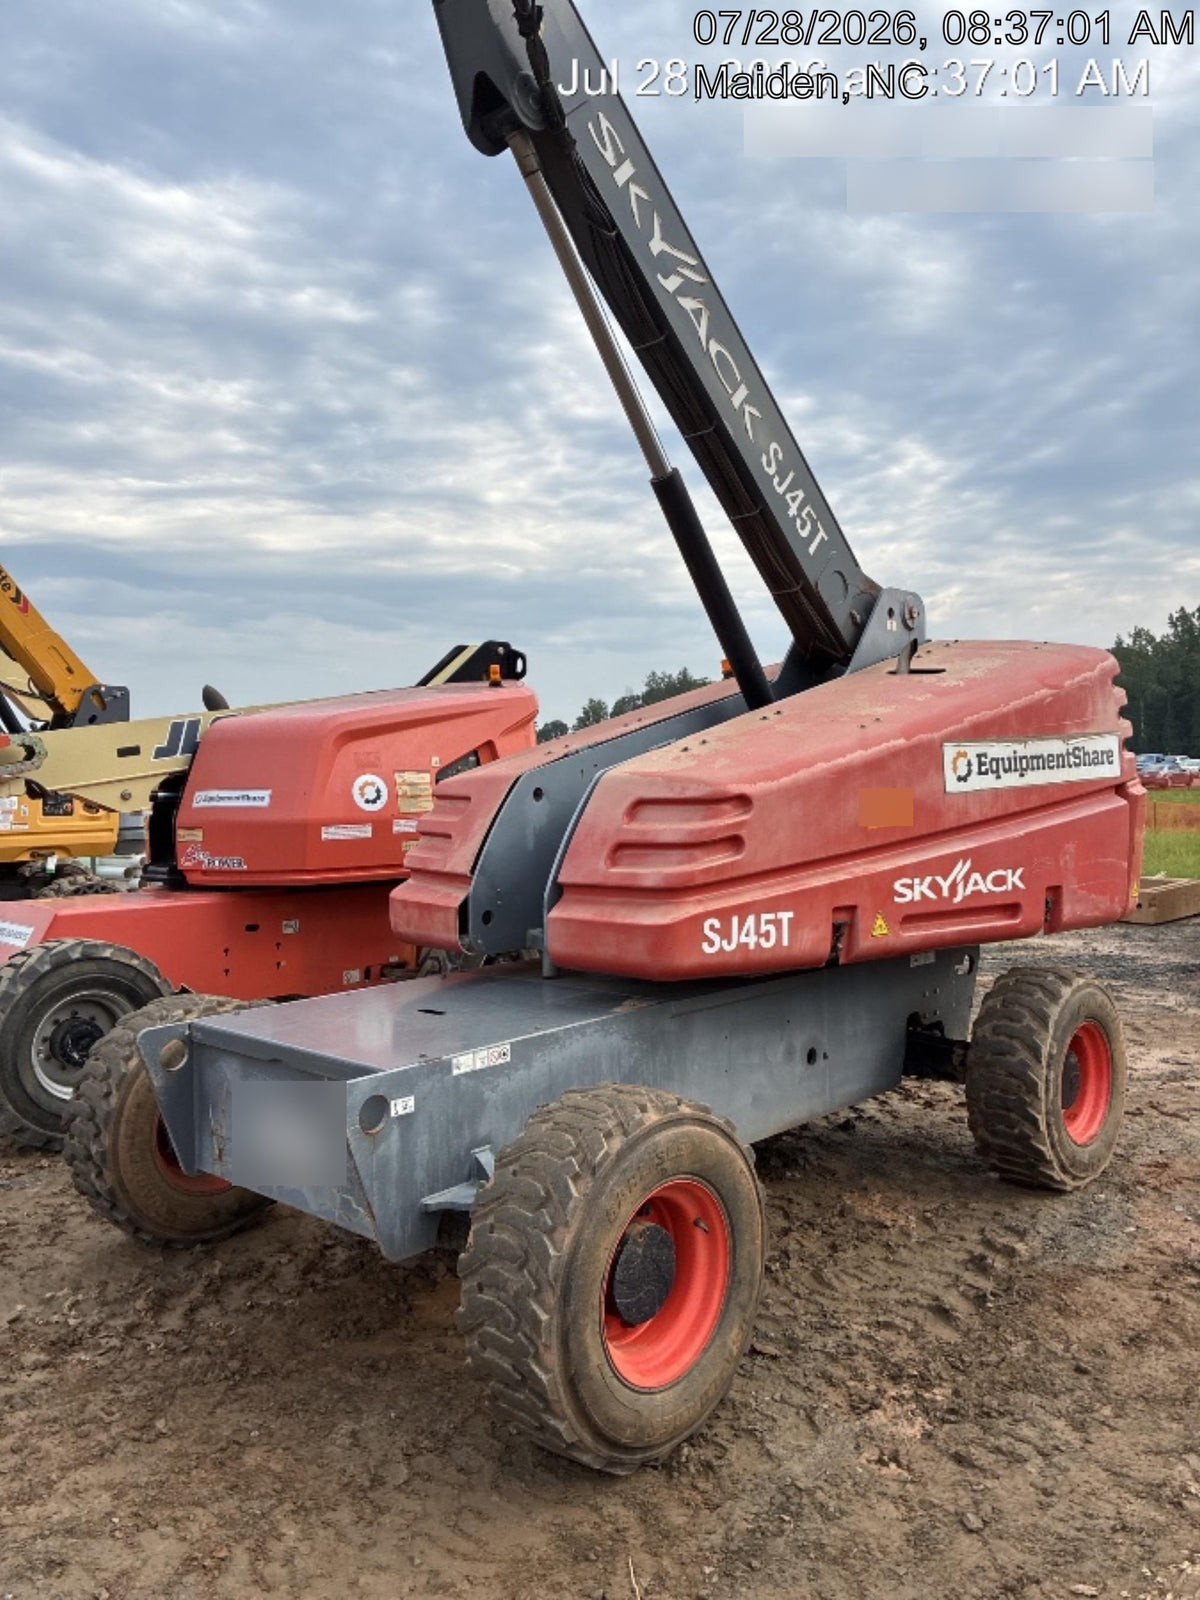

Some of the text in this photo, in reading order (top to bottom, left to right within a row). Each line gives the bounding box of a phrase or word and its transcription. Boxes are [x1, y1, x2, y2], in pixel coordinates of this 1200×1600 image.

[588, 112, 829, 556] SKYJACK SJ45T
[975, 746, 1114, 780] EquipmentShare
[893, 858, 1026, 904] SKYJACK
[701, 911, 793, 954] SJ45T
